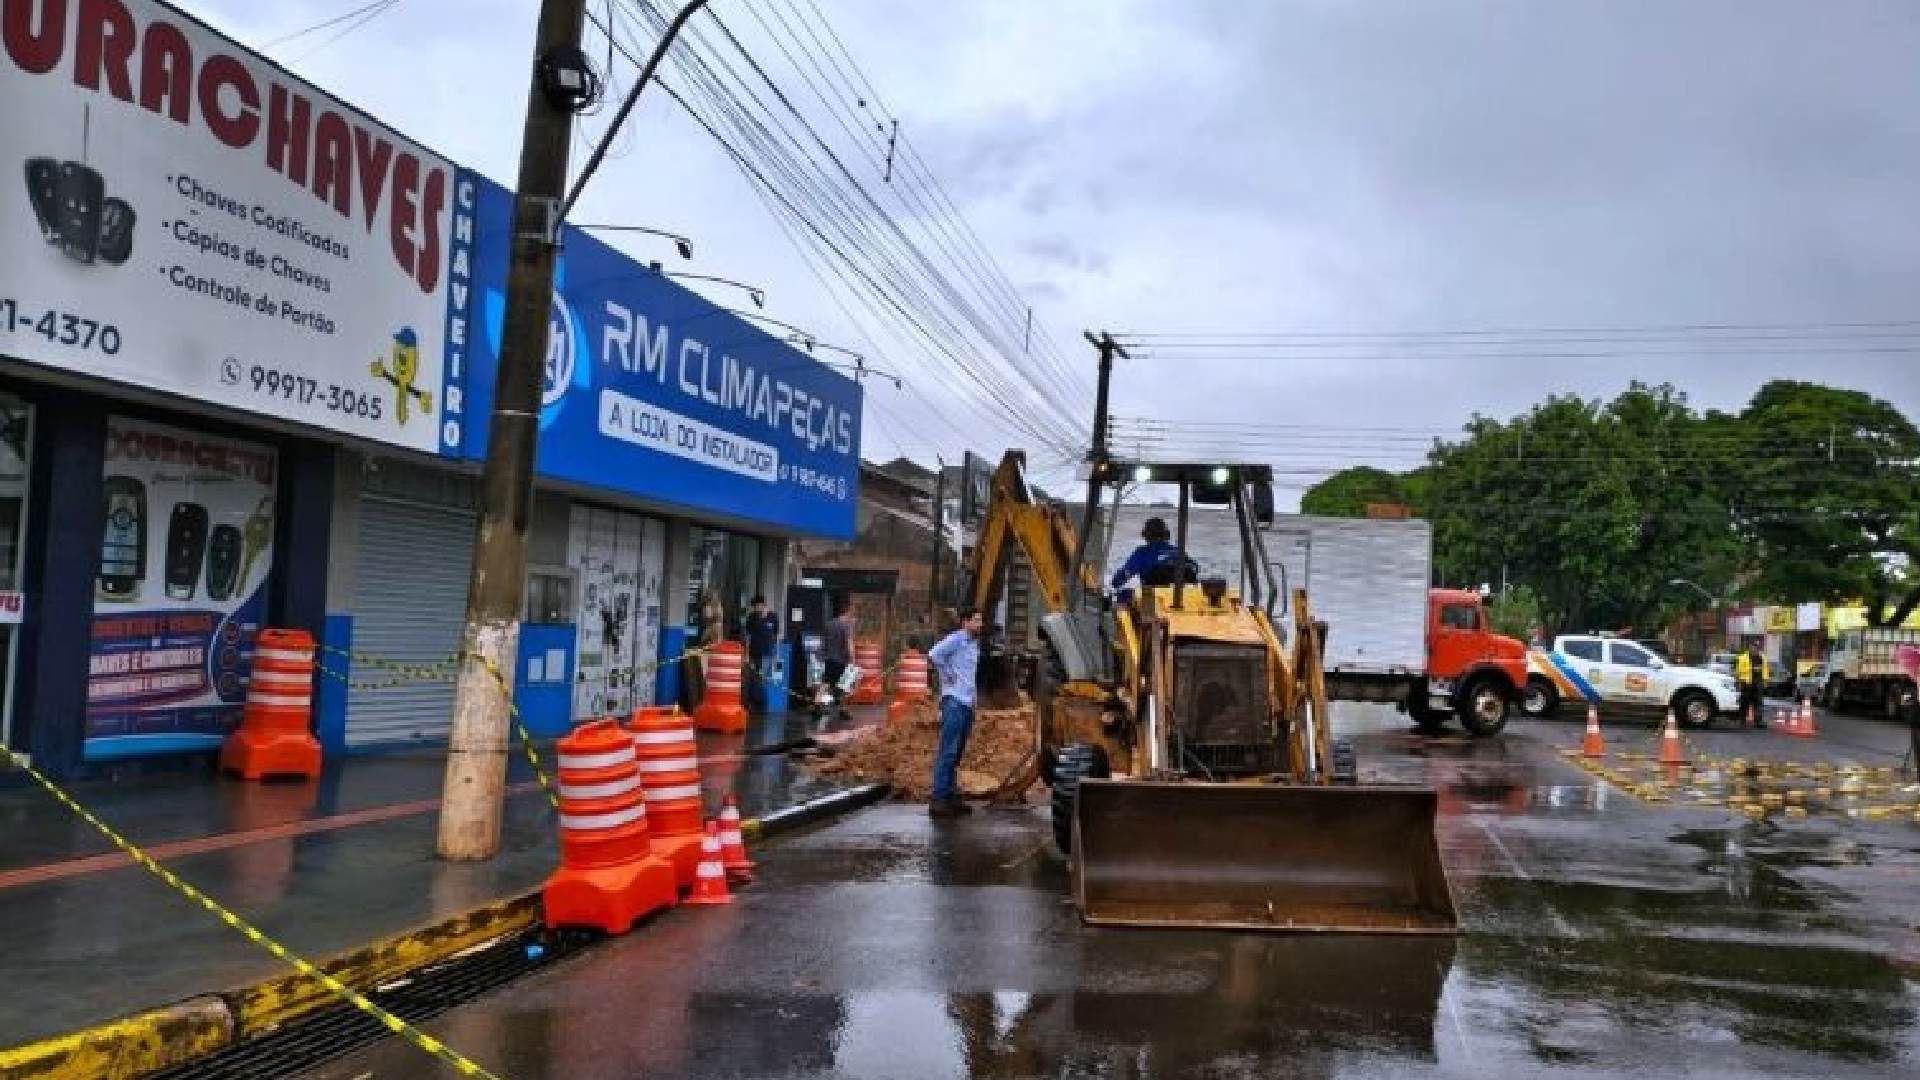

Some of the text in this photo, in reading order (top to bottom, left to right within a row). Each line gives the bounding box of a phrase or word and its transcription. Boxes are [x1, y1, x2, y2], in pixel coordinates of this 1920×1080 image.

[177, 175, 349, 260] Chaves Codificadas
[173, 219, 331, 293] Cópias de Chaves
[0, 298, 121, 355] 1-4370
[169, 265, 335, 334] Controle de Portão
[444, 180, 474, 448] CHAVEIRO
[249, 365, 382, 420] 99917-3065
[602, 299, 670, 386] RM
[678, 338, 852, 455] CLIMAPEÇAS
[608, 401, 624, 429] A
[677, 423, 698, 449] DO
